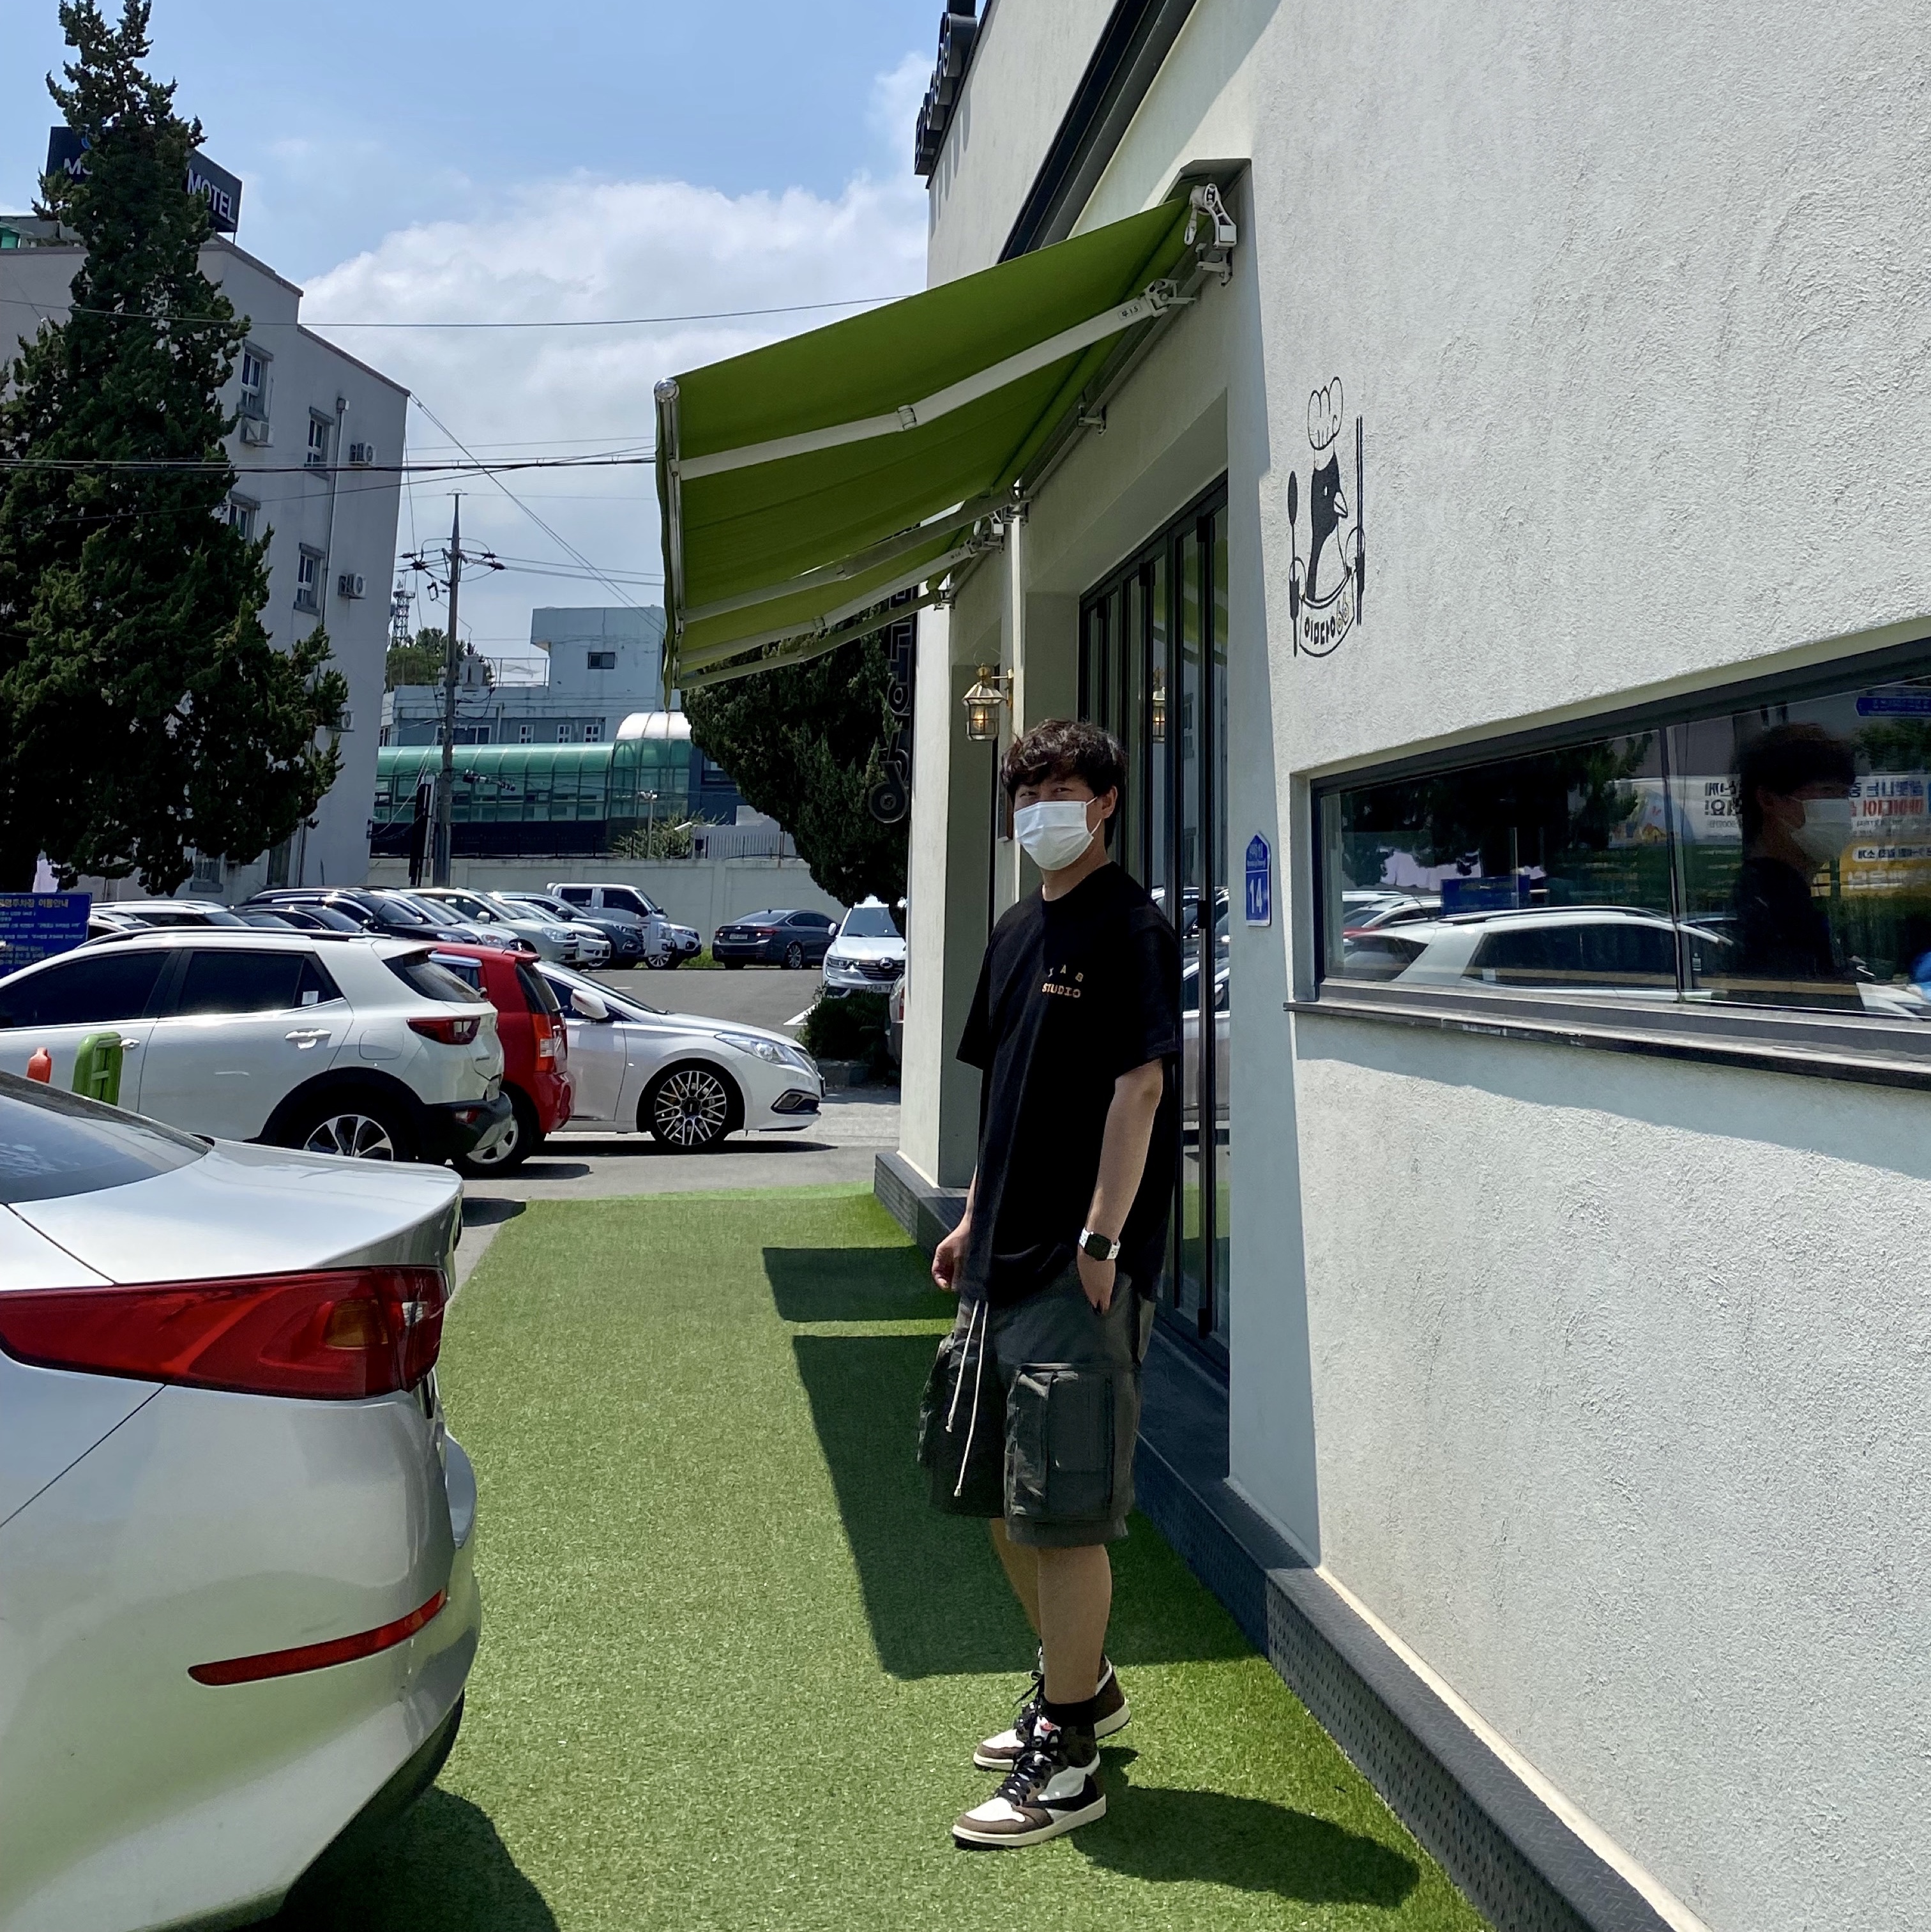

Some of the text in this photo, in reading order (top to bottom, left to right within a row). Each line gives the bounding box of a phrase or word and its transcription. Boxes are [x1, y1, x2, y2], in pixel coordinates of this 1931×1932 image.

[187, 169, 236, 224] MOTEL
[1249, 878, 1262, 914] 14
[1041, 982, 1082, 998] STUDIO
